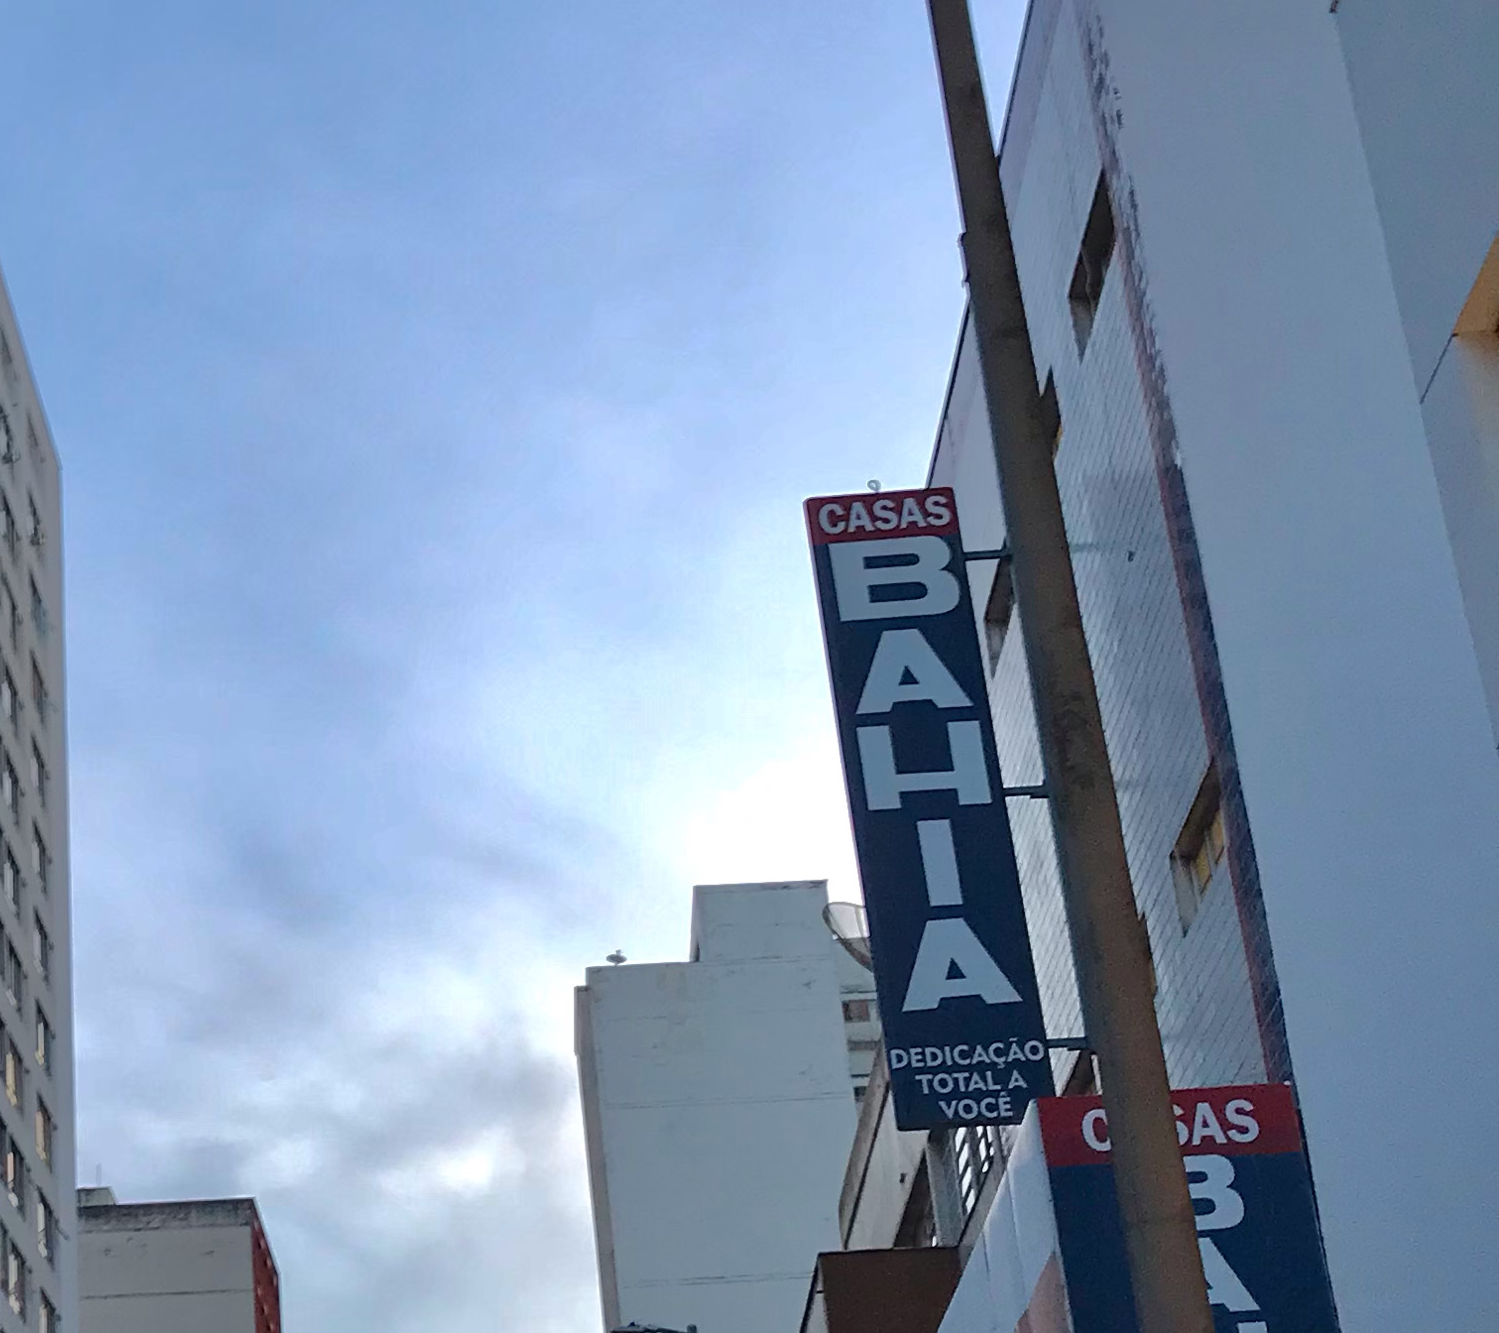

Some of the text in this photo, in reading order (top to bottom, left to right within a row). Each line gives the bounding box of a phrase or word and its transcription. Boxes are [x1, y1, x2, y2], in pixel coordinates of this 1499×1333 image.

[818, 494, 952, 534] CASAS
[826, 533, 1023, 1013] BAHIA
[890, 1036, 1045, 1070] DEDICAÇÃO
[915, 1068, 1029, 1095] TOTAL A
[938, 1092, 1014, 1120] VOCÊ
[1081, 1098, 1260, 1152] CAS
